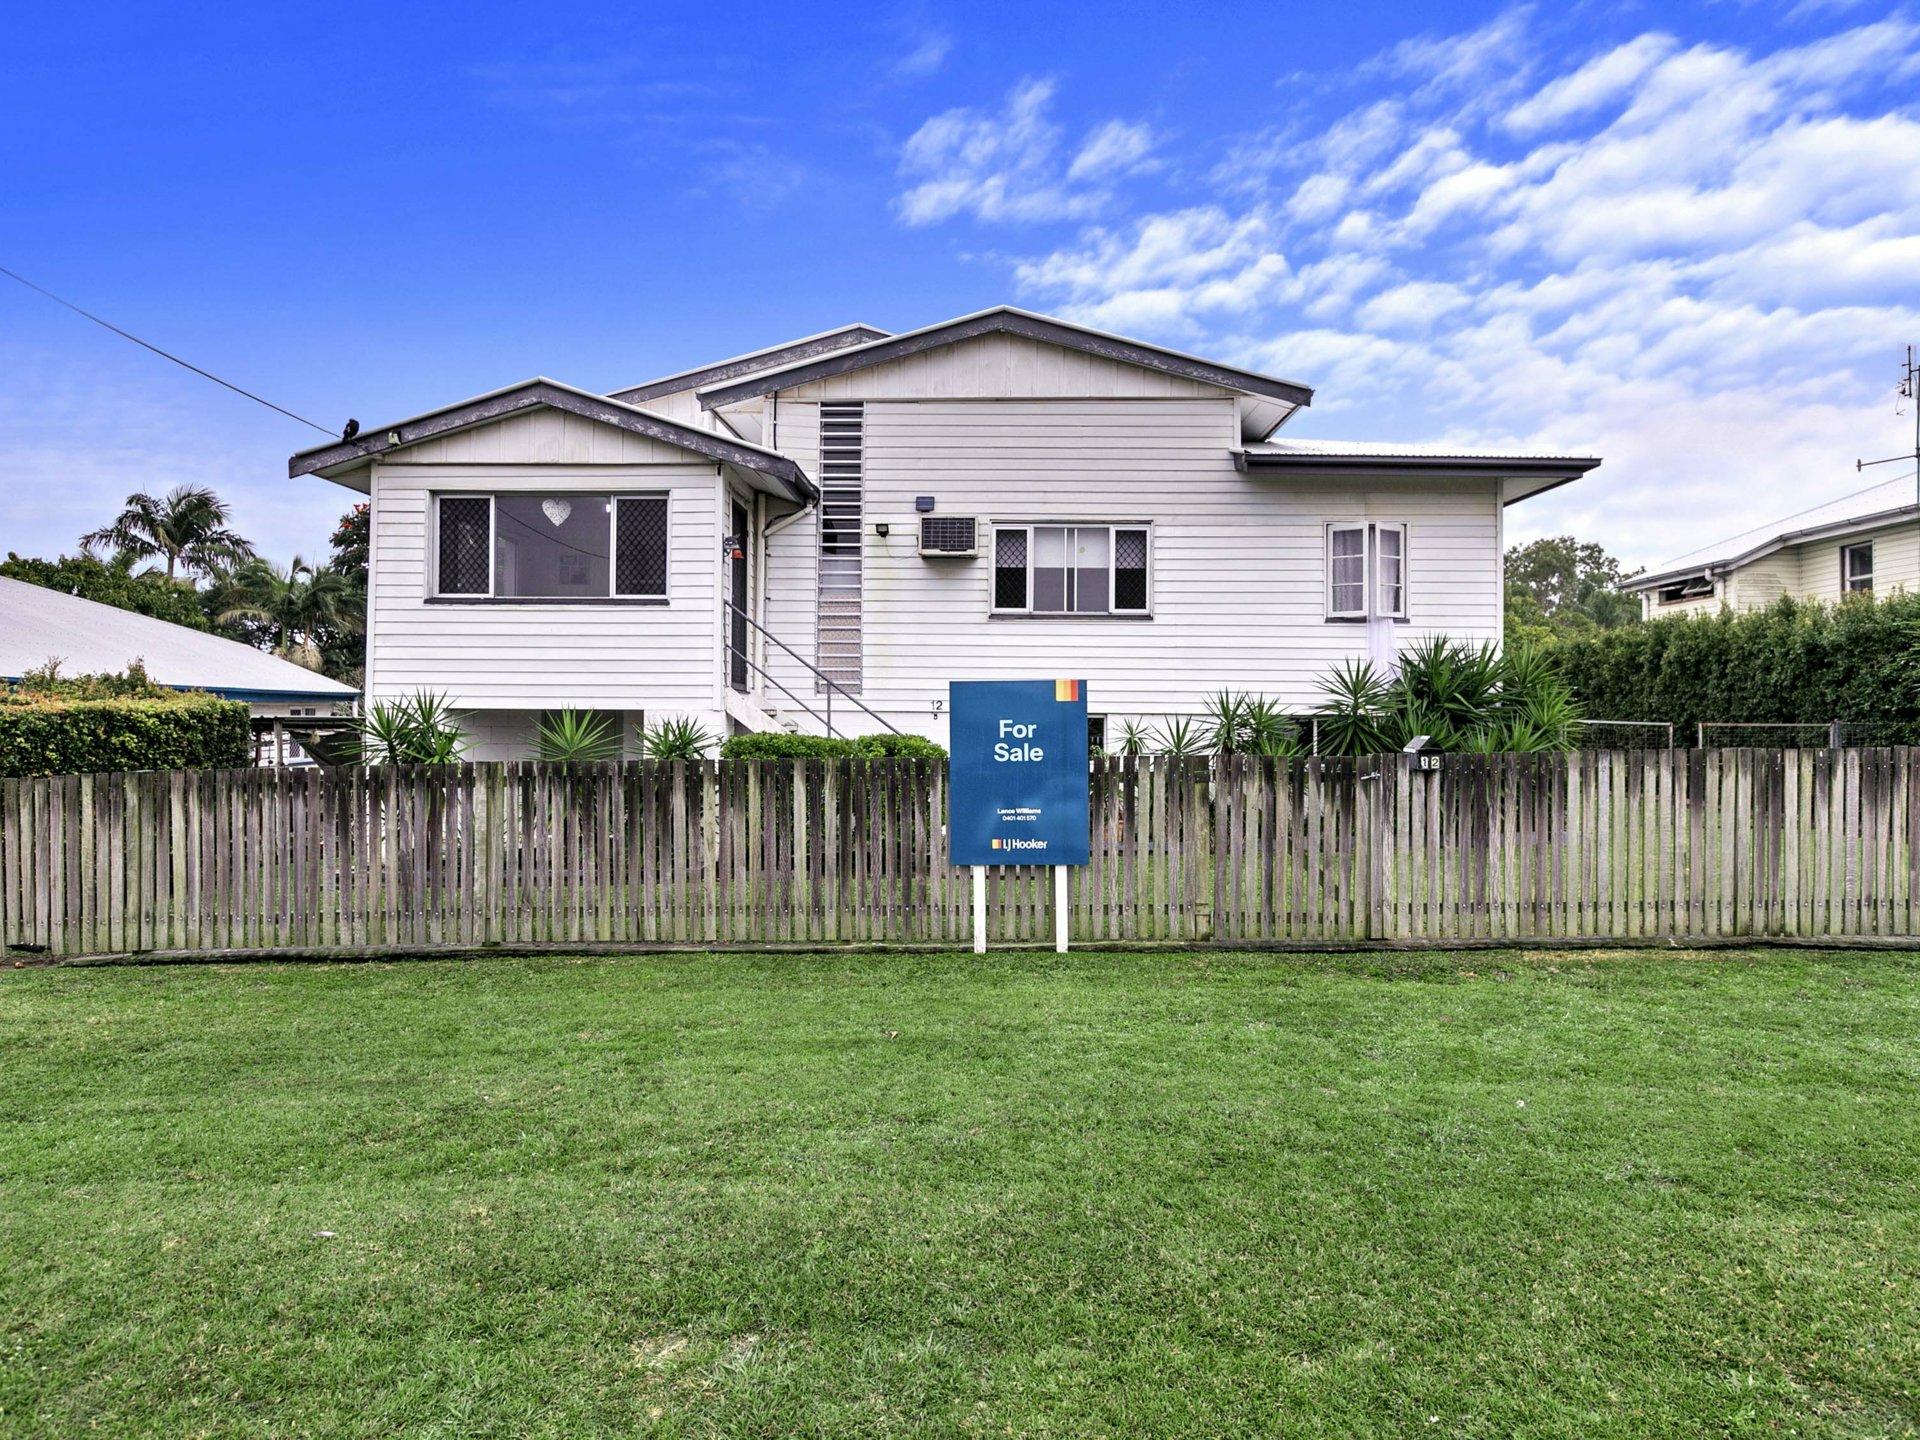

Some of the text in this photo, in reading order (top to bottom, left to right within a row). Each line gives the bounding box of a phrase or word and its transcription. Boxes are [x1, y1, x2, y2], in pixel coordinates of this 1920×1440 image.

[930, 700, 943, 710] 12
[999, 719, 1037, 738] For
[994, 743, 1043, 761] Sale
[1422, 757, 1439, 768] 12
[1012, 838, 1048, 849] Hooker
